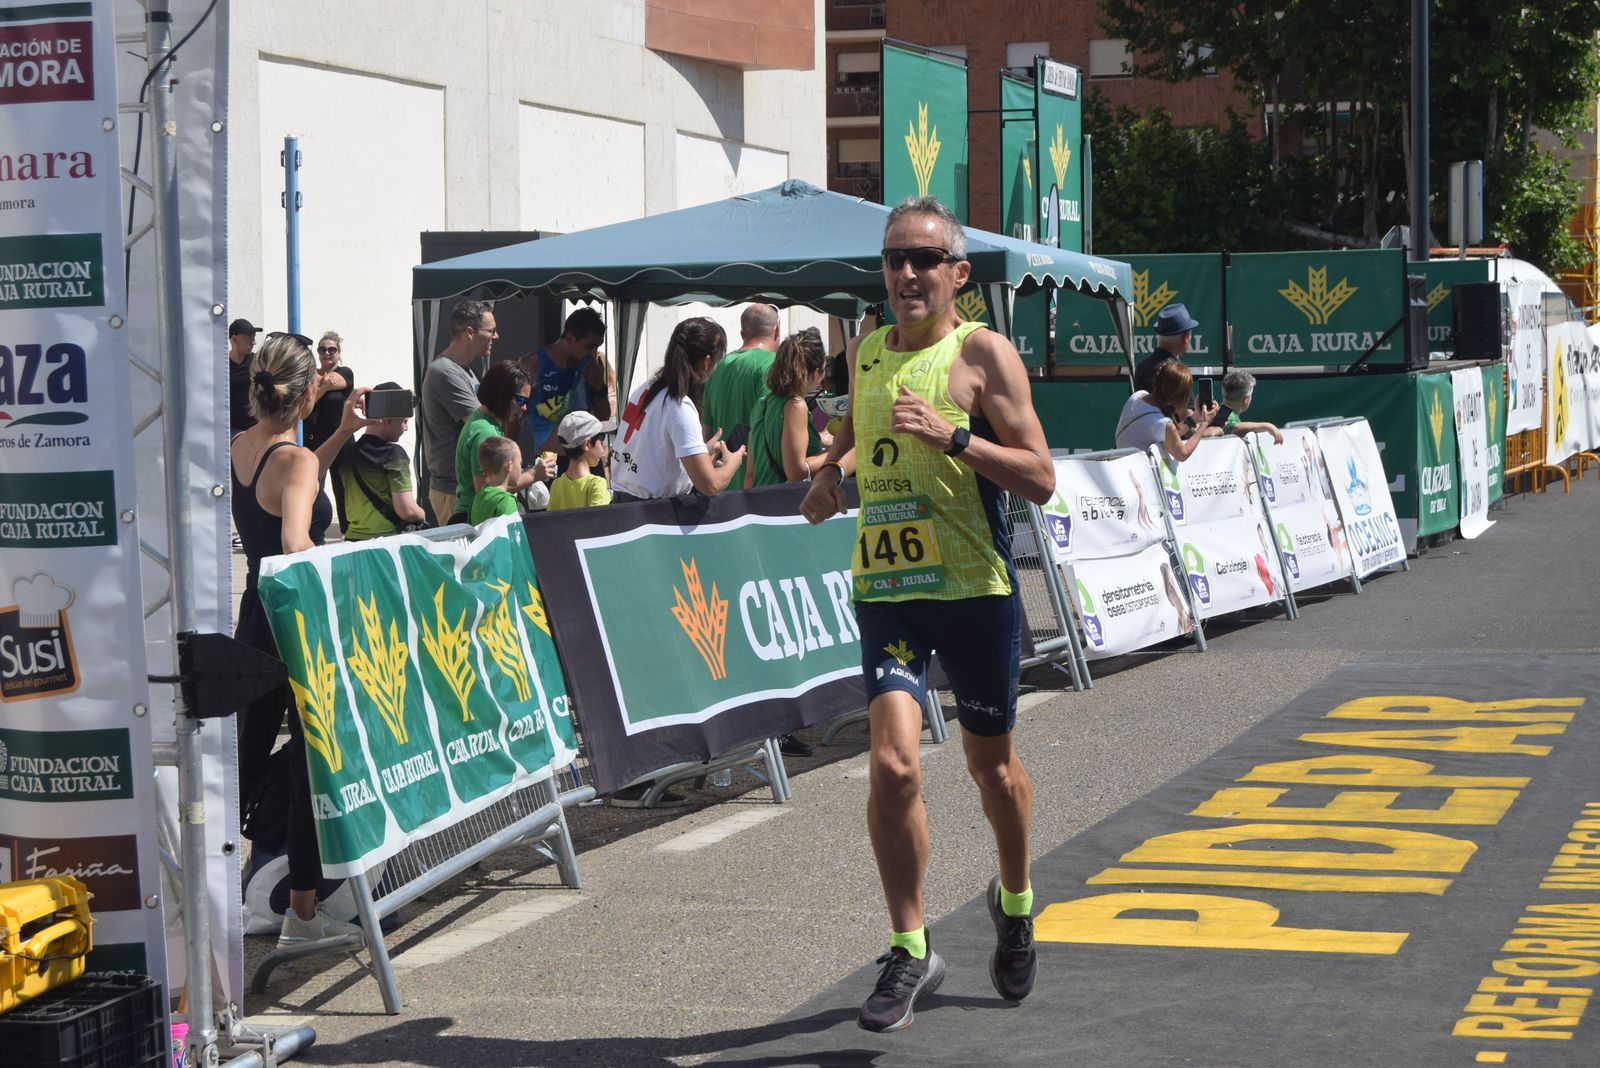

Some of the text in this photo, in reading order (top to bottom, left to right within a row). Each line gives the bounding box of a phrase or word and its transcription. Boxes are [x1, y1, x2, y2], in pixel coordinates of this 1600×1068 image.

[0, 38, 82, 58] ACIÓN DE
[0, 199, 36, 211] mora
[24, 281, 93, 300] RURAL
[1069, 334, 1124, 354] CAJA
[1247, 331, 1392, 354] CAJA RURAL
[17, 432, 31, 448] de
[34, 432, 91, 448] Zamora
[864, 477, 913, 493] Adarsa
[0, 500, 105, 520] FUNDACION
[866, 501, 918, 515] FUNDACION
[866, 510, 919, 524] CAJA RURAL
[1, 520, 106, 541] CAJA RURAL
[1347, 511, 1399, 558] OCEANIC
[859, 526, 925, 570] 146
[902, 572, 940, 589] RURAL
[738, 574, 836, 663] CAJA
[0, 629, 66, 678] Susi
[10, 755, 120, 776] FUNDACION
[403, 749, 440, 785] RURAL
[11, 774, 121, 794] CAJA RURAL
[26, 846, 133, 880] Fariña
